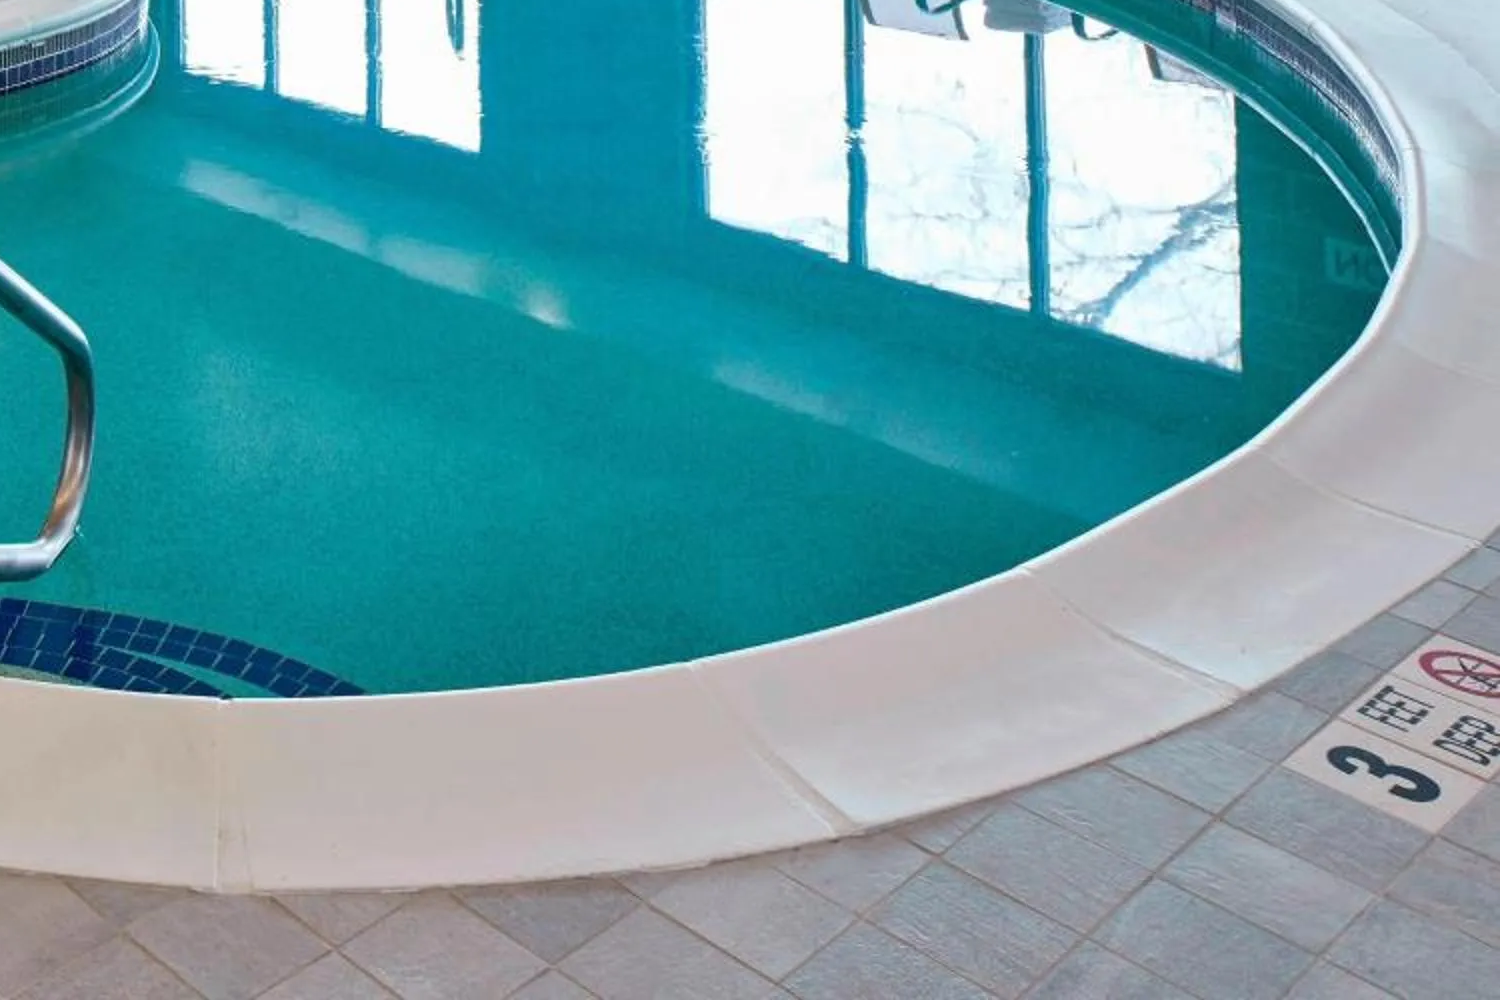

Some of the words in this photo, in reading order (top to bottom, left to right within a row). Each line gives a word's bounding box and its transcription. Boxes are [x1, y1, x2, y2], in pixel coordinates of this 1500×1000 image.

[1356, 685, 1436, 732] FEET
[1432, 715, 1500, 766] DEEP
[1326, 745, 1441, 803] 3
